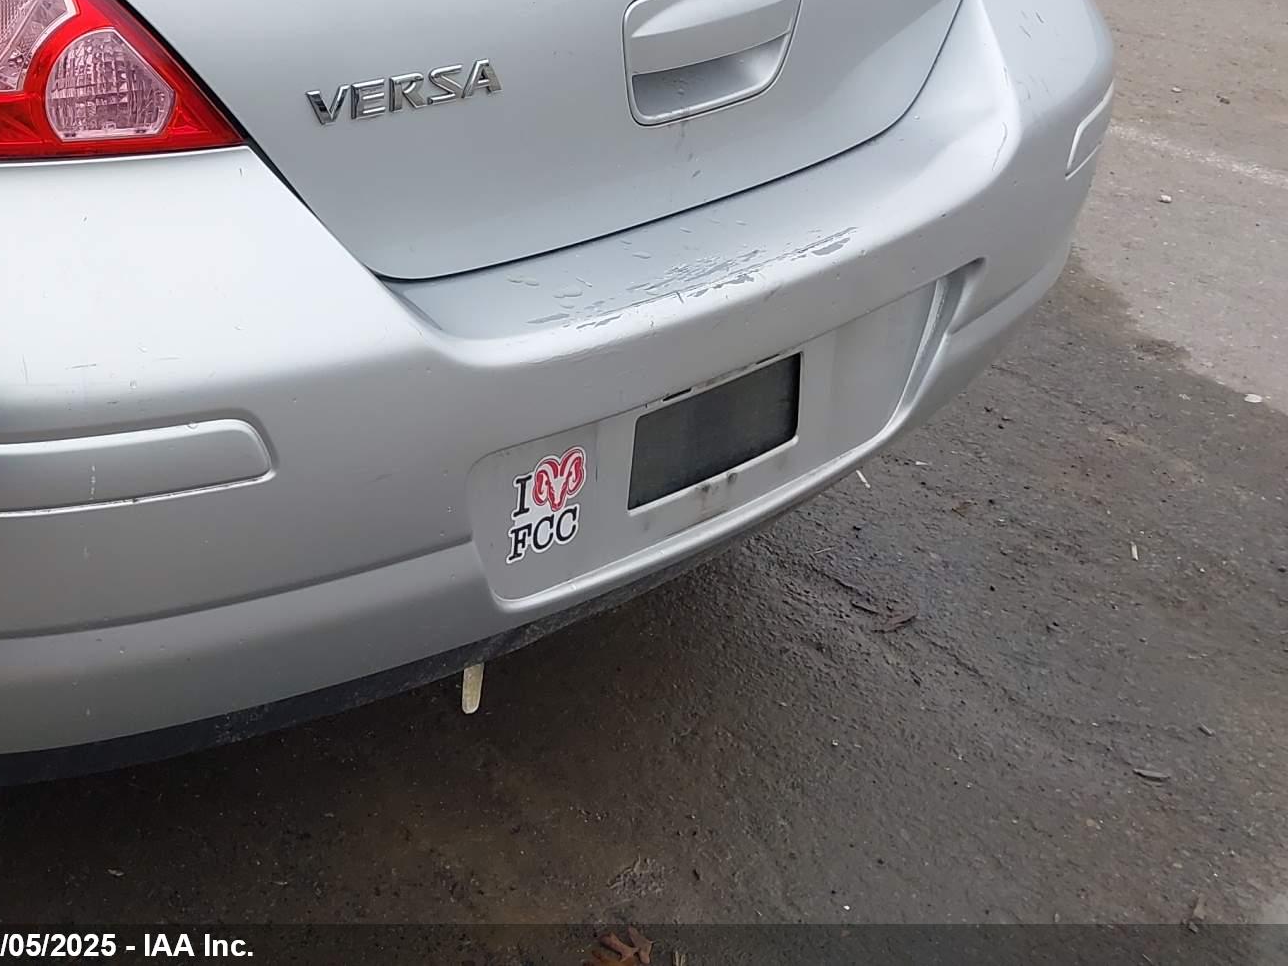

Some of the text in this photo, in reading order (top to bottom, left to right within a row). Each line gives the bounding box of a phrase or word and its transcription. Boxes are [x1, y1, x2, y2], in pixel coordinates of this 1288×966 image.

[305, 57, 504, 127] VERSA
[513, 474, 533, 518] I
[508, 506, 581, 562] FCC
